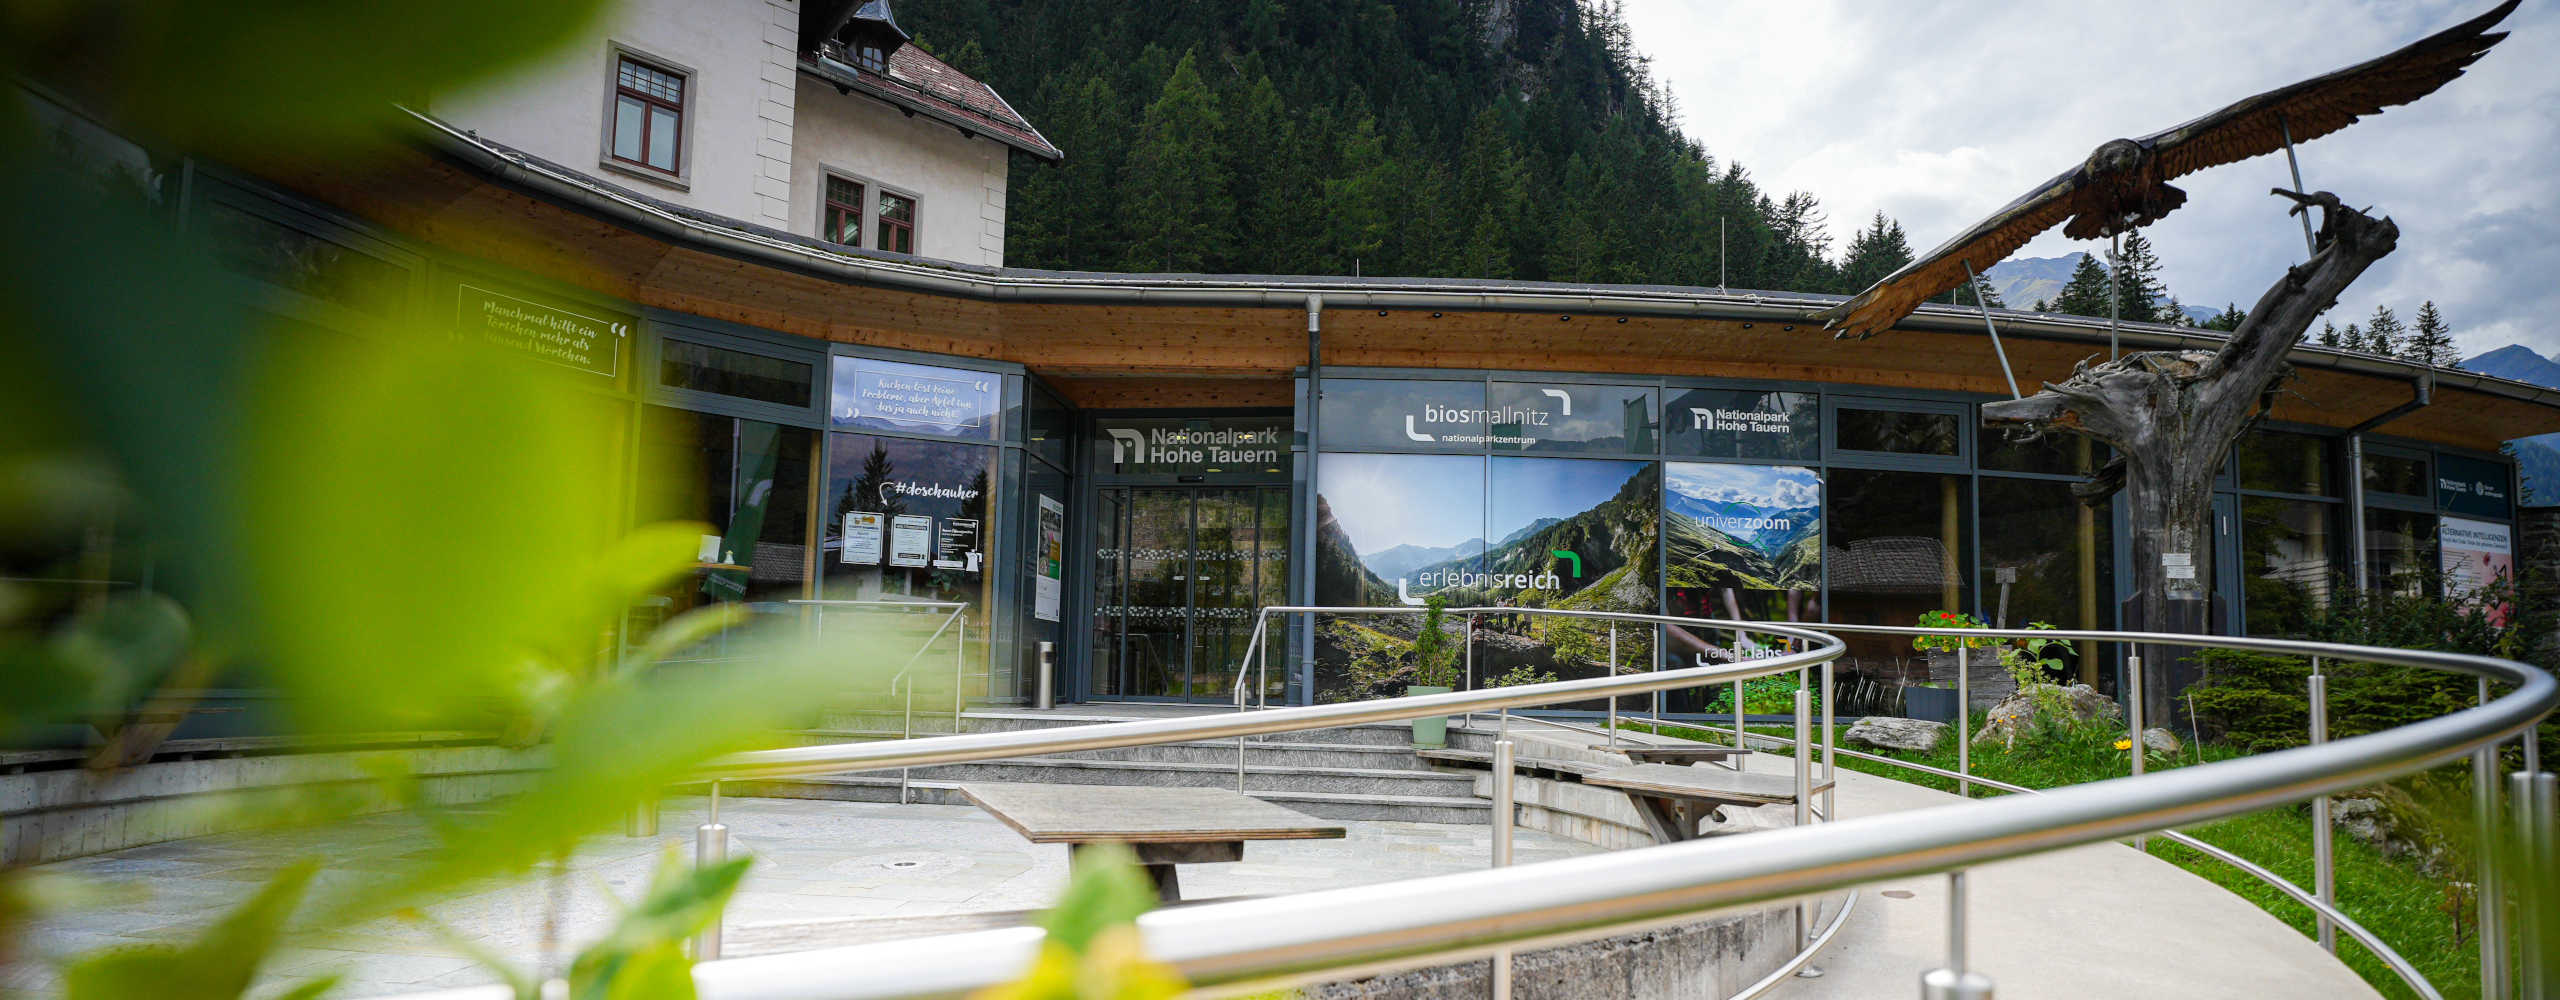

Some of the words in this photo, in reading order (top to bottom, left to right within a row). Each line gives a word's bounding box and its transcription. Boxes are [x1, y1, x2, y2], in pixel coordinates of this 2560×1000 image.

[483, 300, 549, 326] Manchmal
[550, 318, 577, 333] hilft
[577, 326, 599, 339] ein
[1425, 403, 1550, 426] biosmallnitz
[1716, 408, 1790, 424] Nationalpark
[1716, 420, 1748, 432] Hohe
[1750, 421, 1790, 433] Tauern
[1151, 427, 1279, 447] Nationalpark
[1441, 433, 1536, 445] nationalparkzentrum
[1151, 447, 1203, 464] Hohe
[1208, 447, 1277, 463] Tauern
[1695, 513, 1790, 531] univerzoom
[1419, 567, 1560, 590] erlebnisreich
